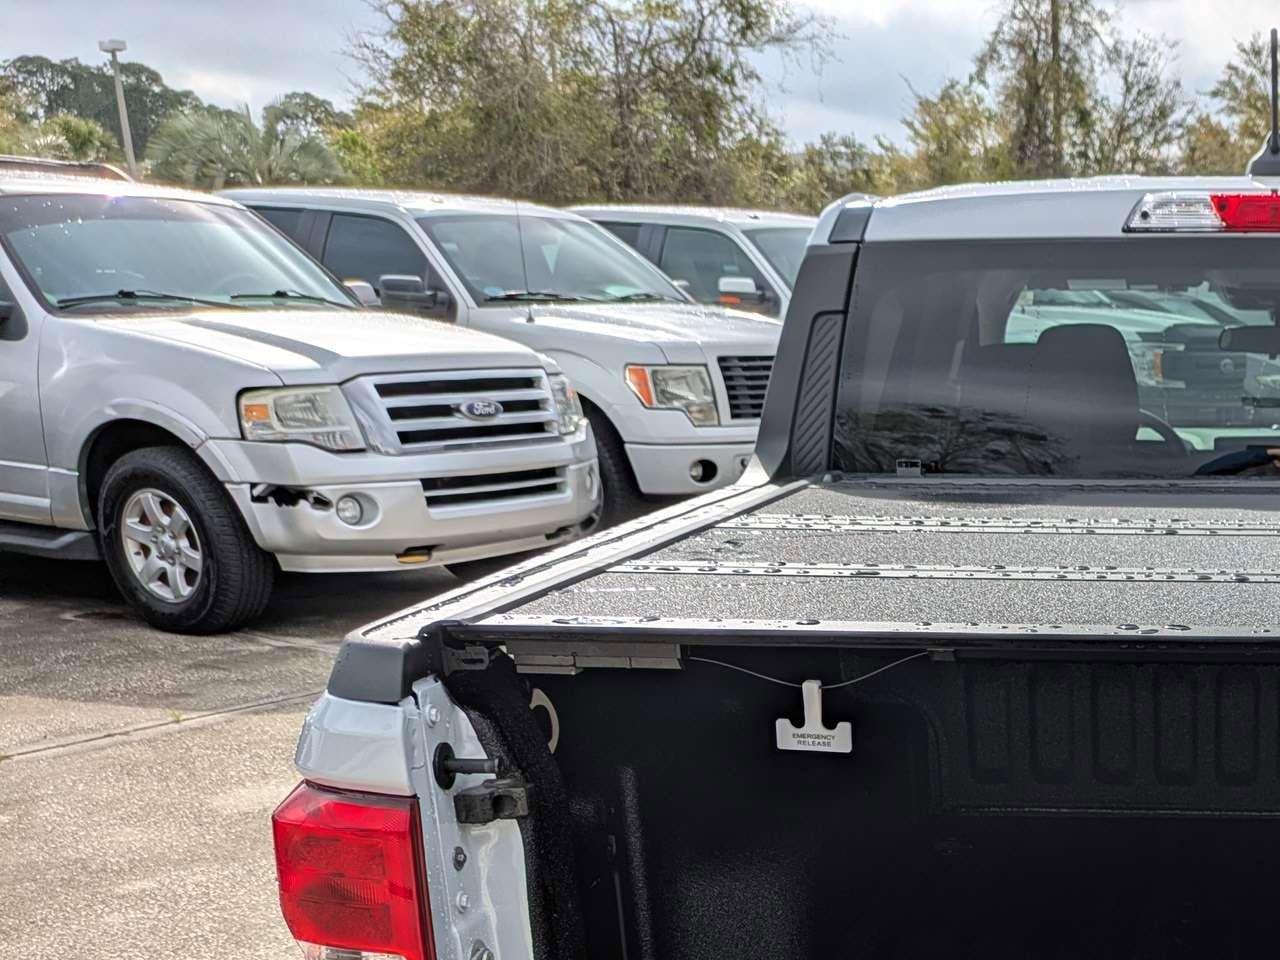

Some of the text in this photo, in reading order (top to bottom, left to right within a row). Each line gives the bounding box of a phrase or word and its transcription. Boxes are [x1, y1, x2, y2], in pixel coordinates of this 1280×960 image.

[474, 401, 496, 415] Ford
[792, 733, 835, 741] EMERGENCY
[797, 740, 832, 748] RELEASE
